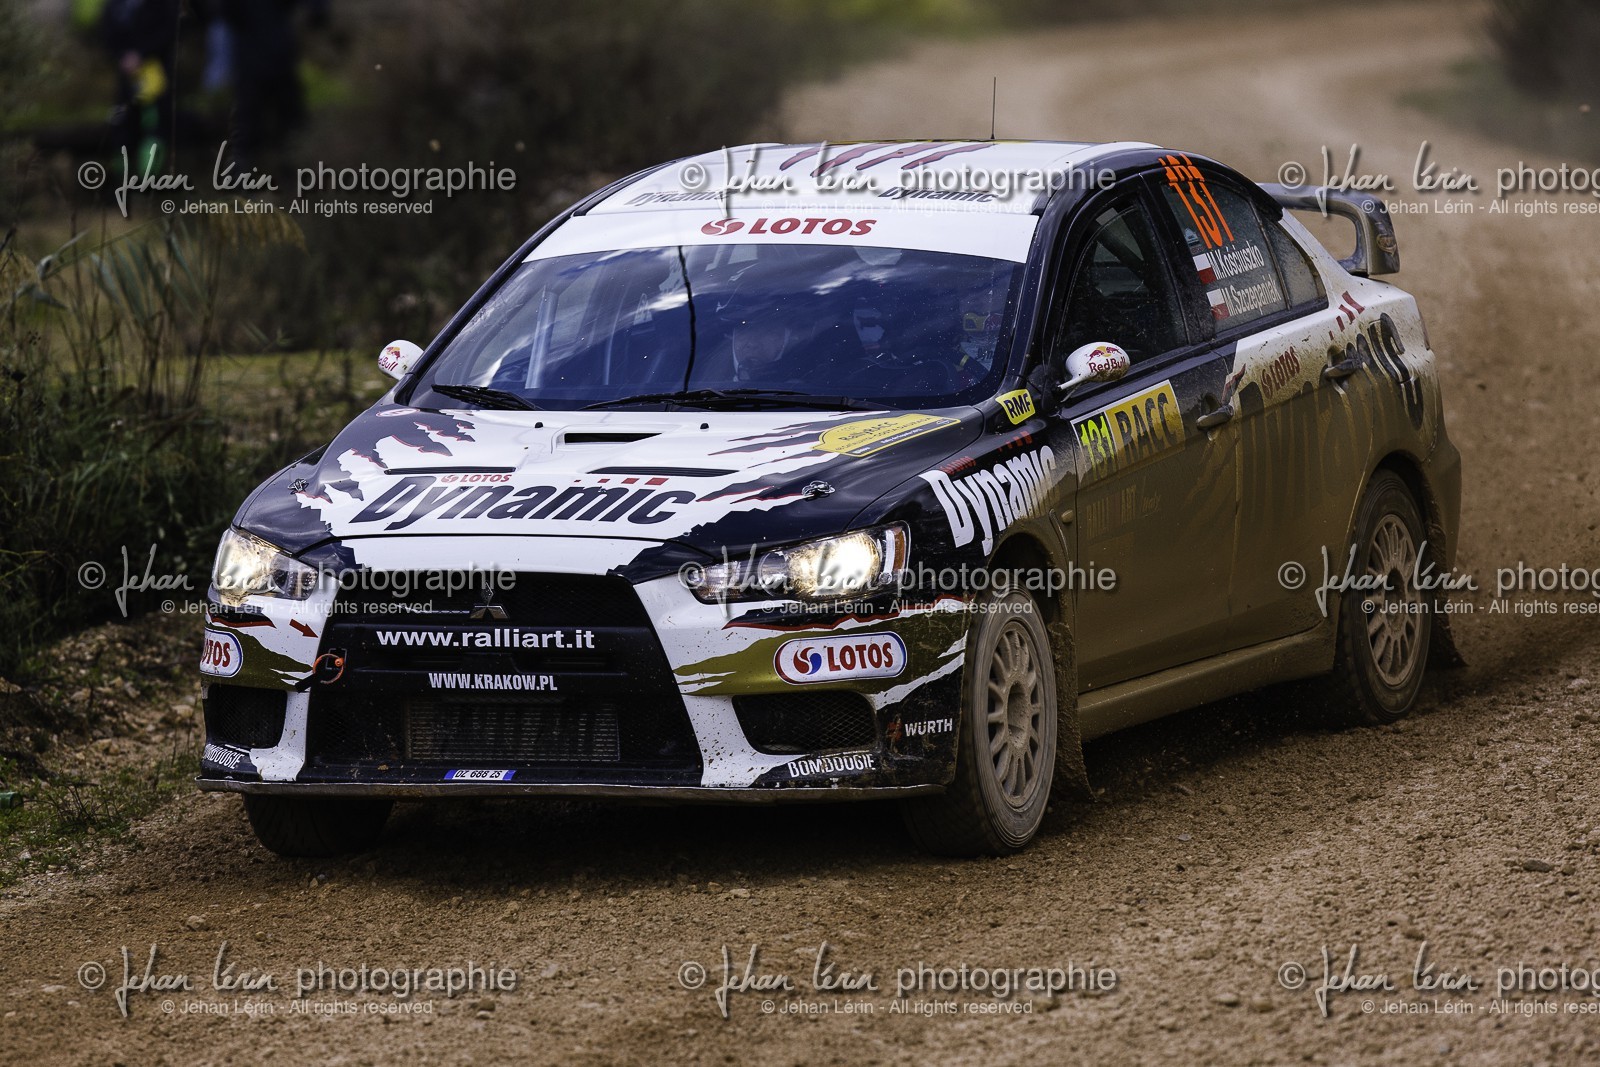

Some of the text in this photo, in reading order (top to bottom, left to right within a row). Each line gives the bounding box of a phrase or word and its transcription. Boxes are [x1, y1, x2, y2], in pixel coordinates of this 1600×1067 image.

[877, 186, 998, 203] Dynamic
[1158, 153, 1235, 250] 131
[748, 217, 878, 236] LOTOS
[1088, 356, 1126, 373] Red Bull
[1269, 346, 1300, 390] LOTOS
[1003, 393, 1031, 419] RMF
[1080, 392, 1178, 481] 131 RACC
[460, 473, 512, 484] LOTOS
[348, 475, 697, 531] Dynamic
[918, 445, 1056, 557] Dynamic
[376, 628, 595, 649] www.ralliart.it
[827, 642, 894, 672] LOTOS
[428, 672, 558, 691] WWW.KRAKOW.PL
[905, 718, 953, 737] WÜRTH
[787, 753, 876, 778] BOMBOOGIE
